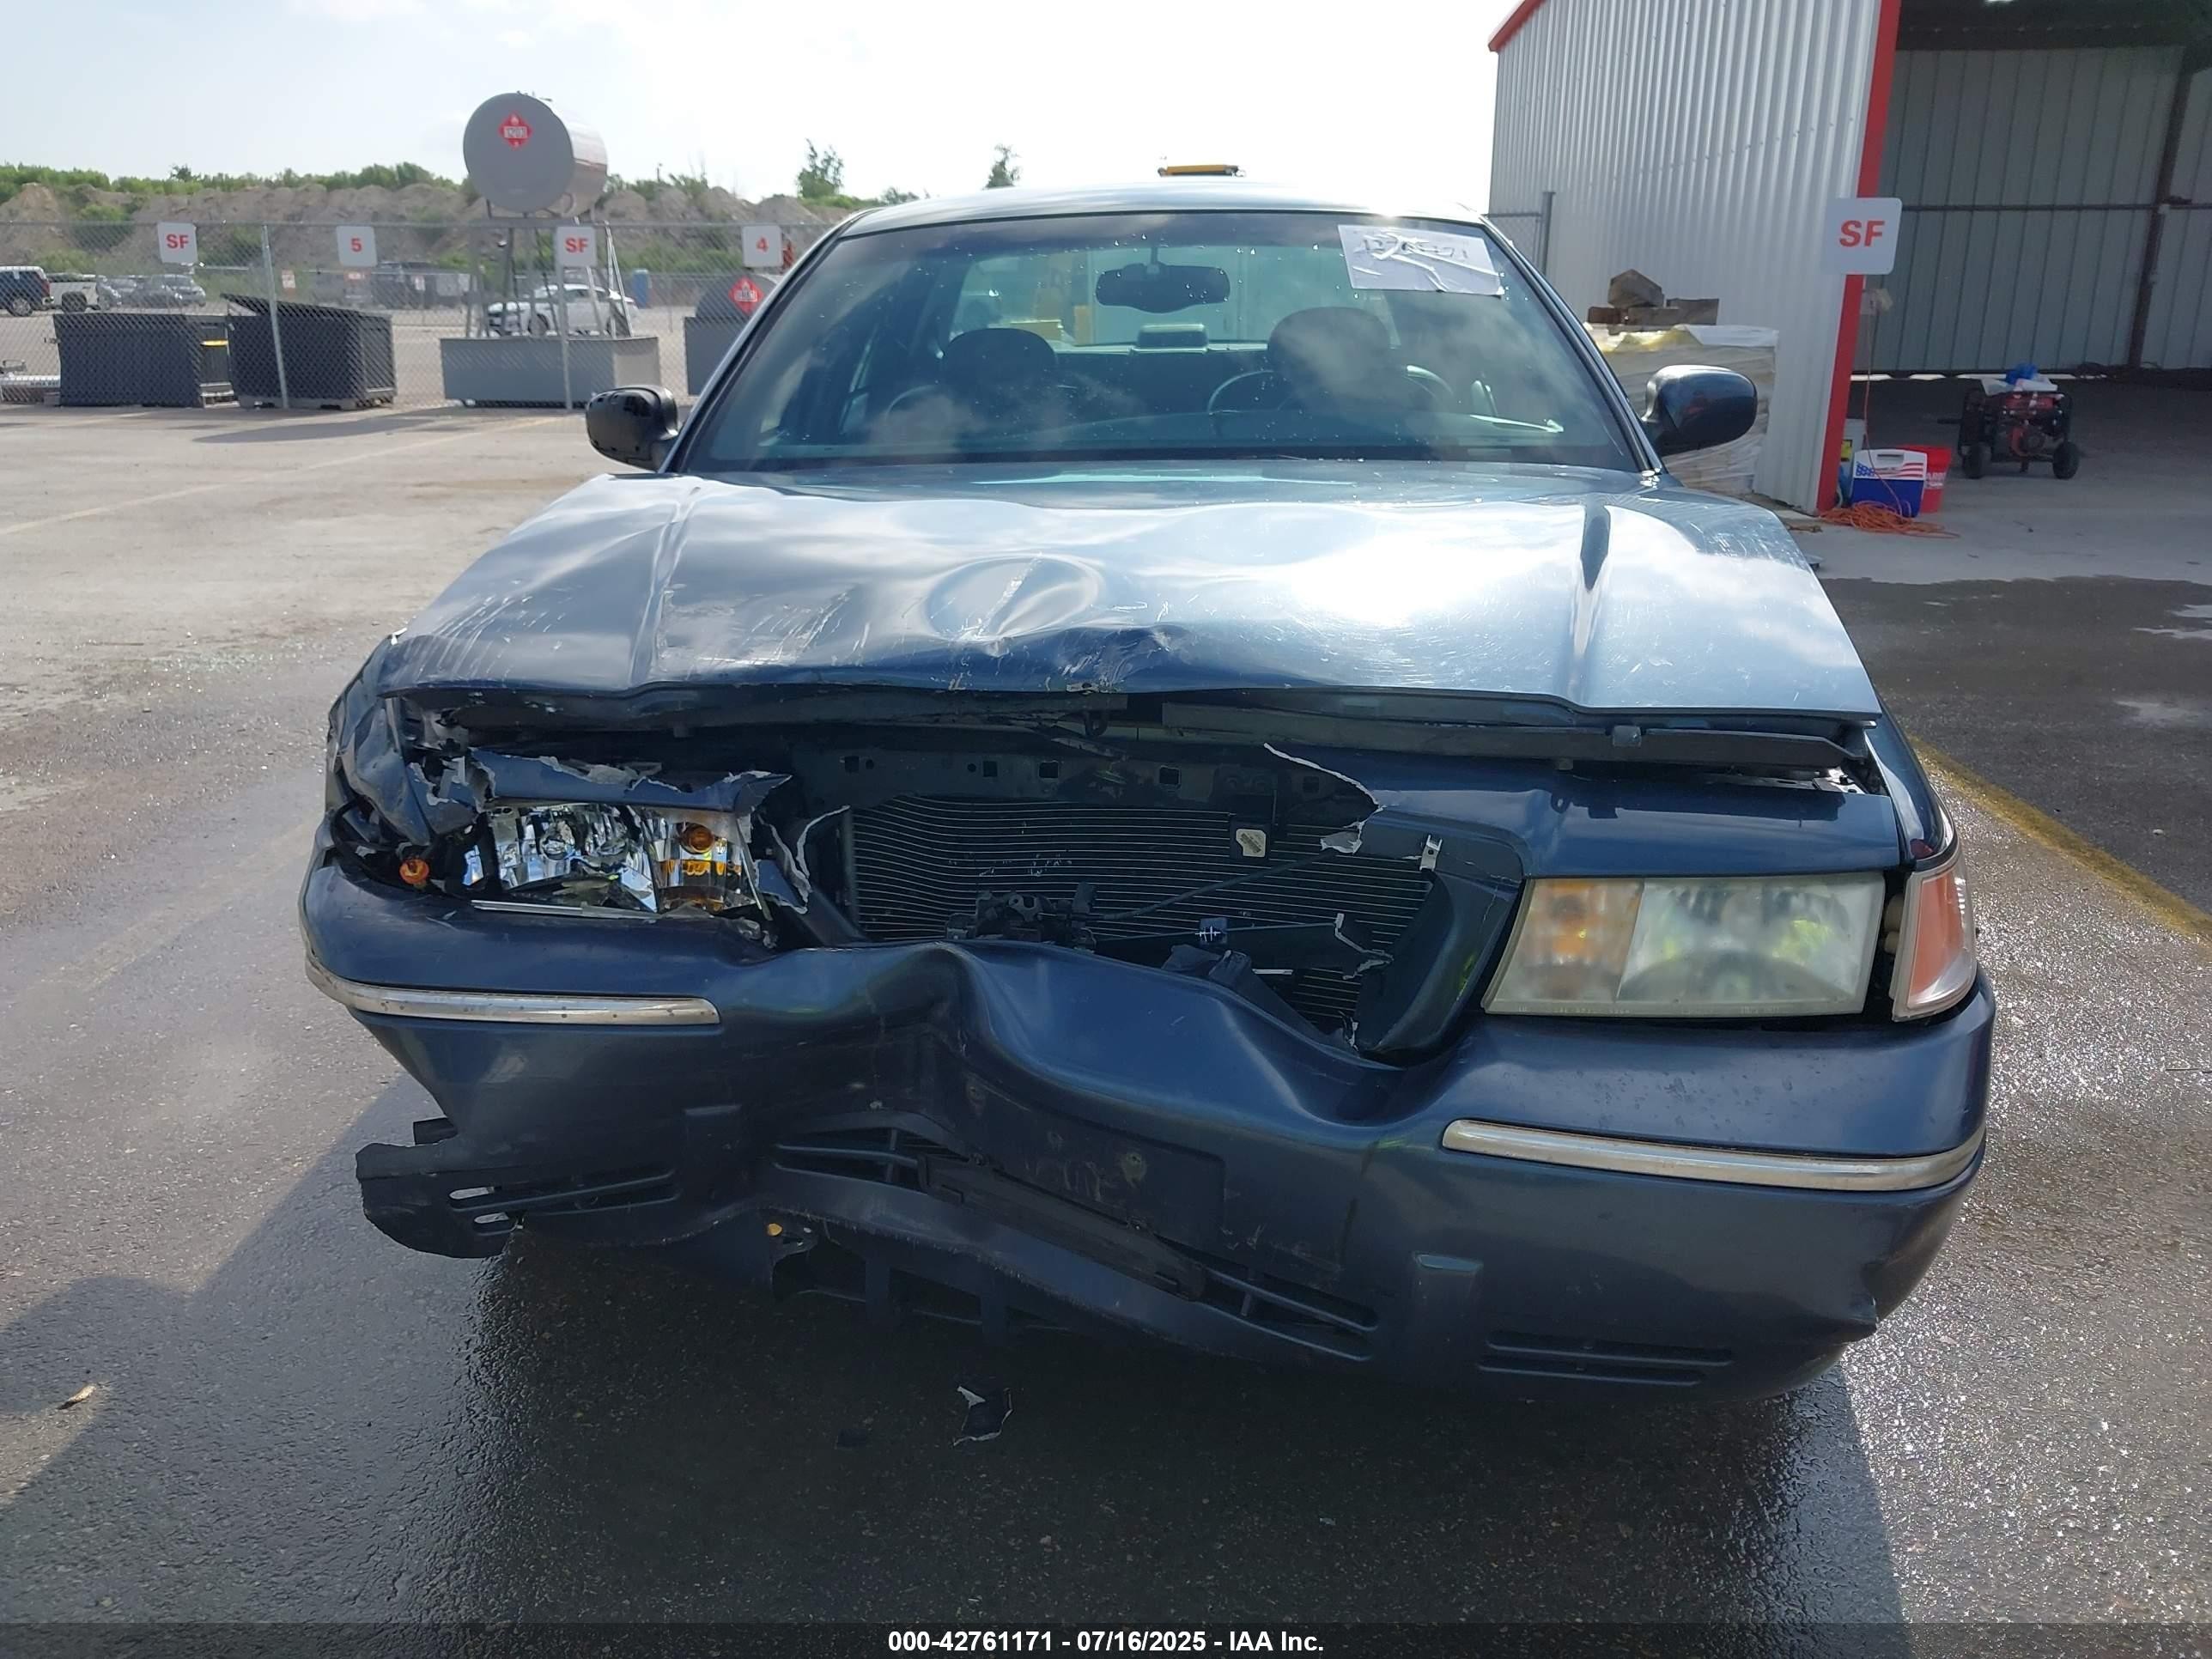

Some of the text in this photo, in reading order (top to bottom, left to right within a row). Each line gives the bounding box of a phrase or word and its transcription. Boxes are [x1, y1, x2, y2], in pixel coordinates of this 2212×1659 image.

[1839, 220, 1885, 247] SF
[167, 234, 189, 249] SF
[350, 238, 362, 252] 5
[565, 238, 588, 252] SF
[757, 237, 769, 252] 4
